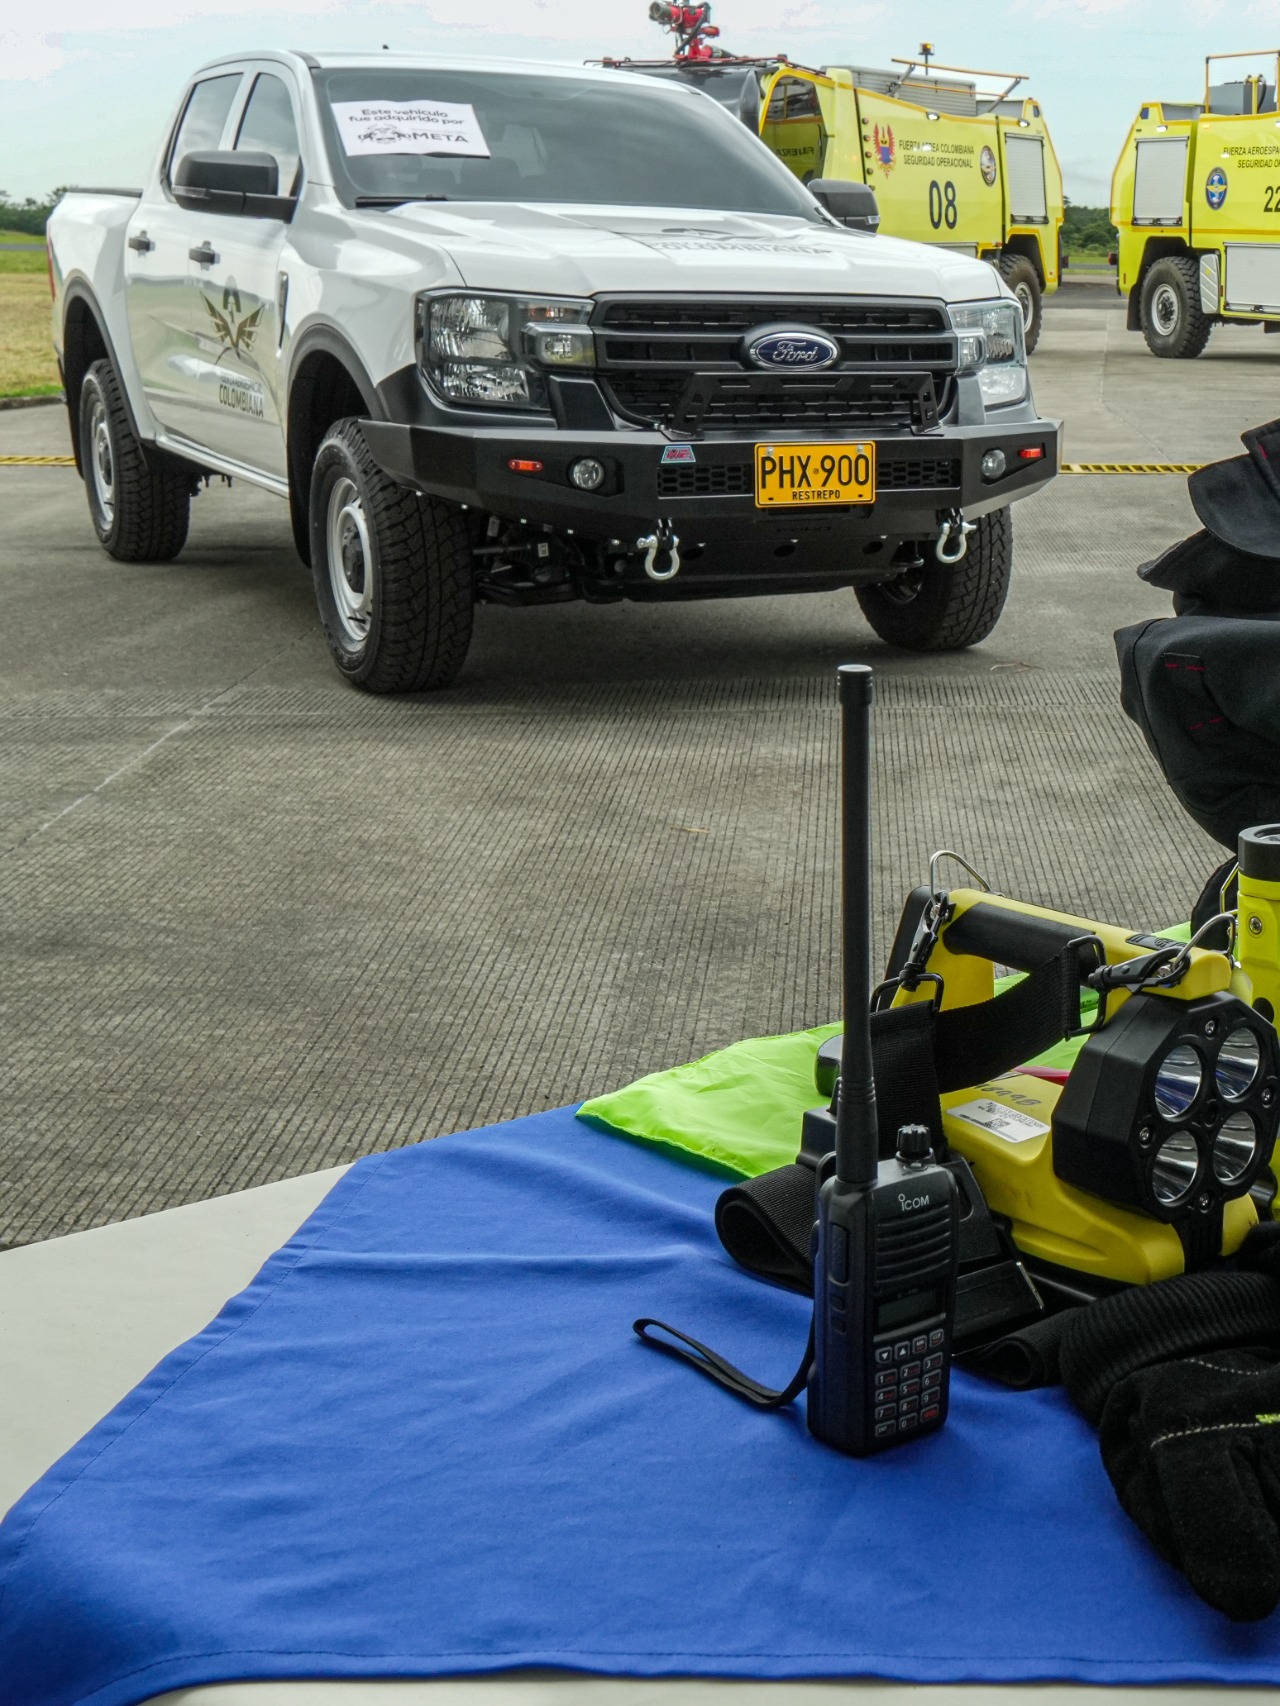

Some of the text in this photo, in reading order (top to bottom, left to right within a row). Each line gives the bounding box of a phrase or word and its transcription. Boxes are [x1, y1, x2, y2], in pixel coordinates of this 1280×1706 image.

[361, 108, 391, 116] Este
[374, 114, 439, 124] adquirido
[441, 117, 465, 125] por
[413, 131, 469, 143] META
[898, 139, 921, 151] FUERZA
[941, 144, 974, 154] COLOMBIANA
[1223, 146, 1247, 156] FUERZA
[904, 155, 973, 168] SEGURIDAD OPERACIONAL
[1237, 159, 1274, 169] SEGURIDAD
[929, 179, 958, 230] 08
[772, 340, 819, 363] Ford
[219, 383, 264, 418] COLOMBIANA
[792, 489, 841, 501] RESTREPO
[926, 1360, 931, 1369] 3
[903, 1368, 909, 1377] 2
[924, 1377, 930, 1386] 6
[902, 1386, 908, 1394] 5
[878, 1392, 884, 1401] 4
[923, 1394, 929, 1403] 9
[902, 1403, 908, 1411] 8
[879, 1409, 884, 1418] 7
[901, 1420, 907, 1429] 0
